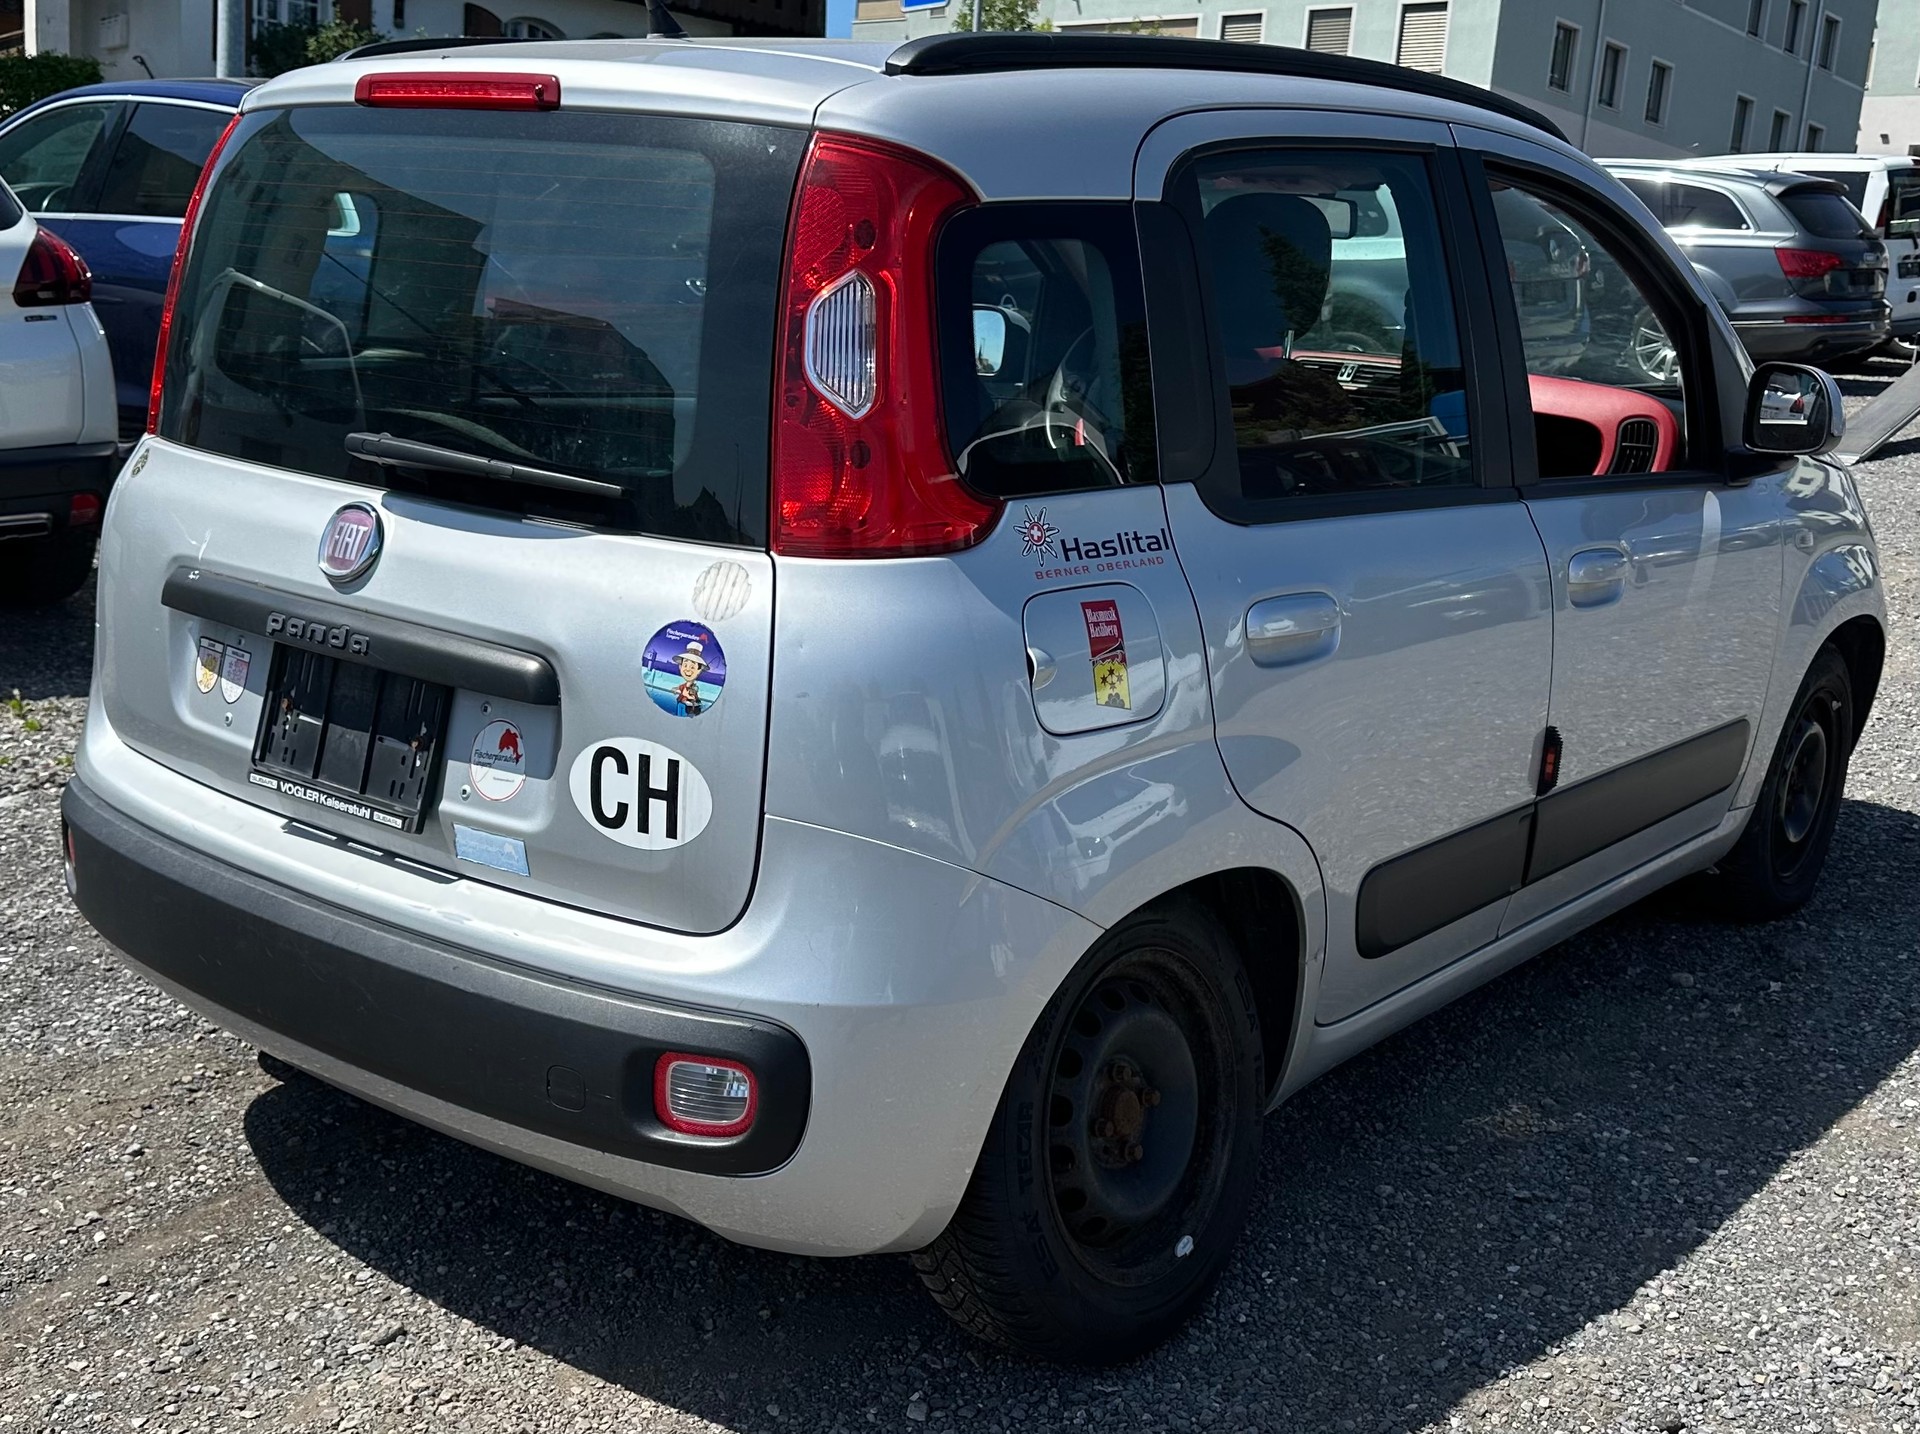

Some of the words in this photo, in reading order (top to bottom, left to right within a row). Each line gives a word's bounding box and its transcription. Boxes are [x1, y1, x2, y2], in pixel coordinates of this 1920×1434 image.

[329, 522, 369, 561] FIAT
[1060, 528, 1170, 562] Haslital
[1035, 565, 1091, 580] BERNER
[1096, 556, 1165, 573] OBERLAND
[266, 611, 370, 656] panda
[280, 781, 319, 803] VOGLER
[320, 794, 370, 819] Kaiserstuhl
[590, 746, 680, 840] CH
